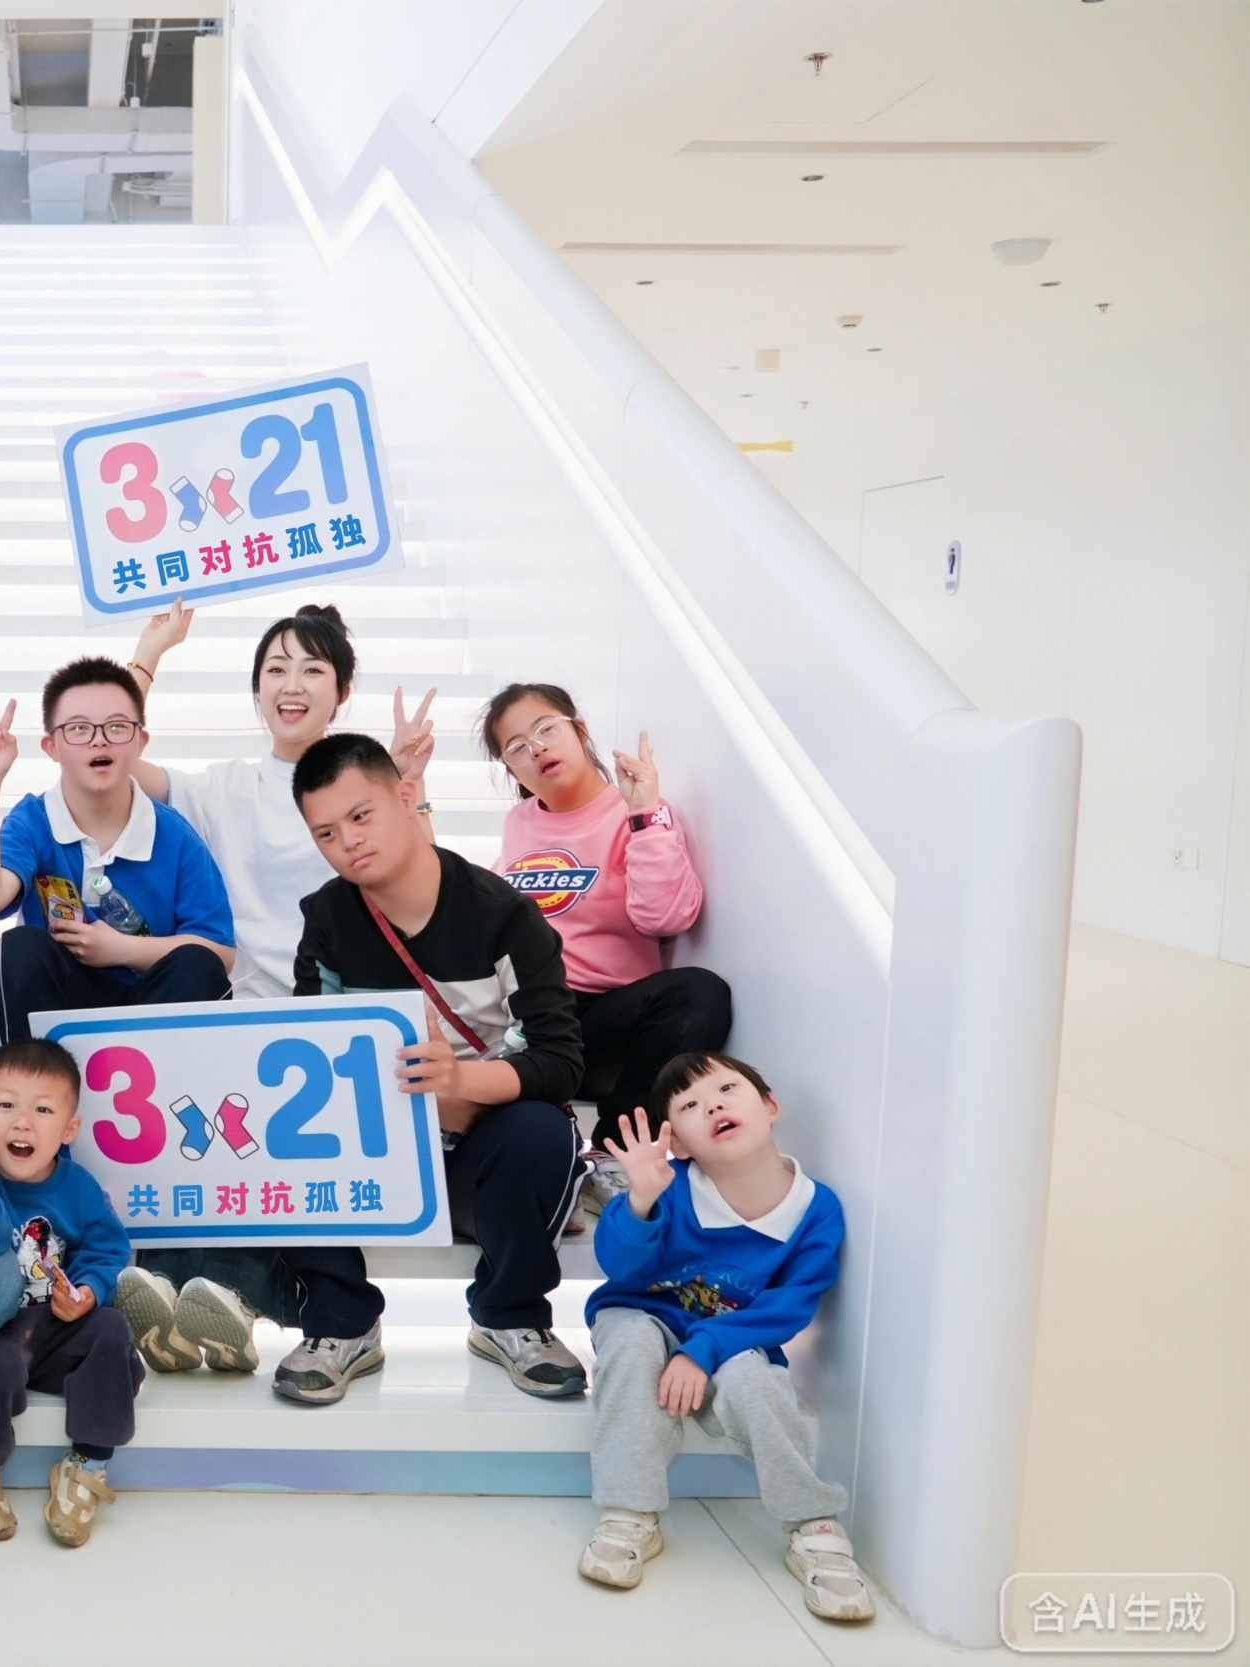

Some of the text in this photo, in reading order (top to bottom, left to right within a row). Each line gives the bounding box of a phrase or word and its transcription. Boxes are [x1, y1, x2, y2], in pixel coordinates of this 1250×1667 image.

[100, 403, 349, 543] 3 21
[111, 514, 367, 595] 共同对抗孤独
[85, 1034, 389, 1165] 3 21
[126, 1178, 384, 1217] 共同对抗孤独
